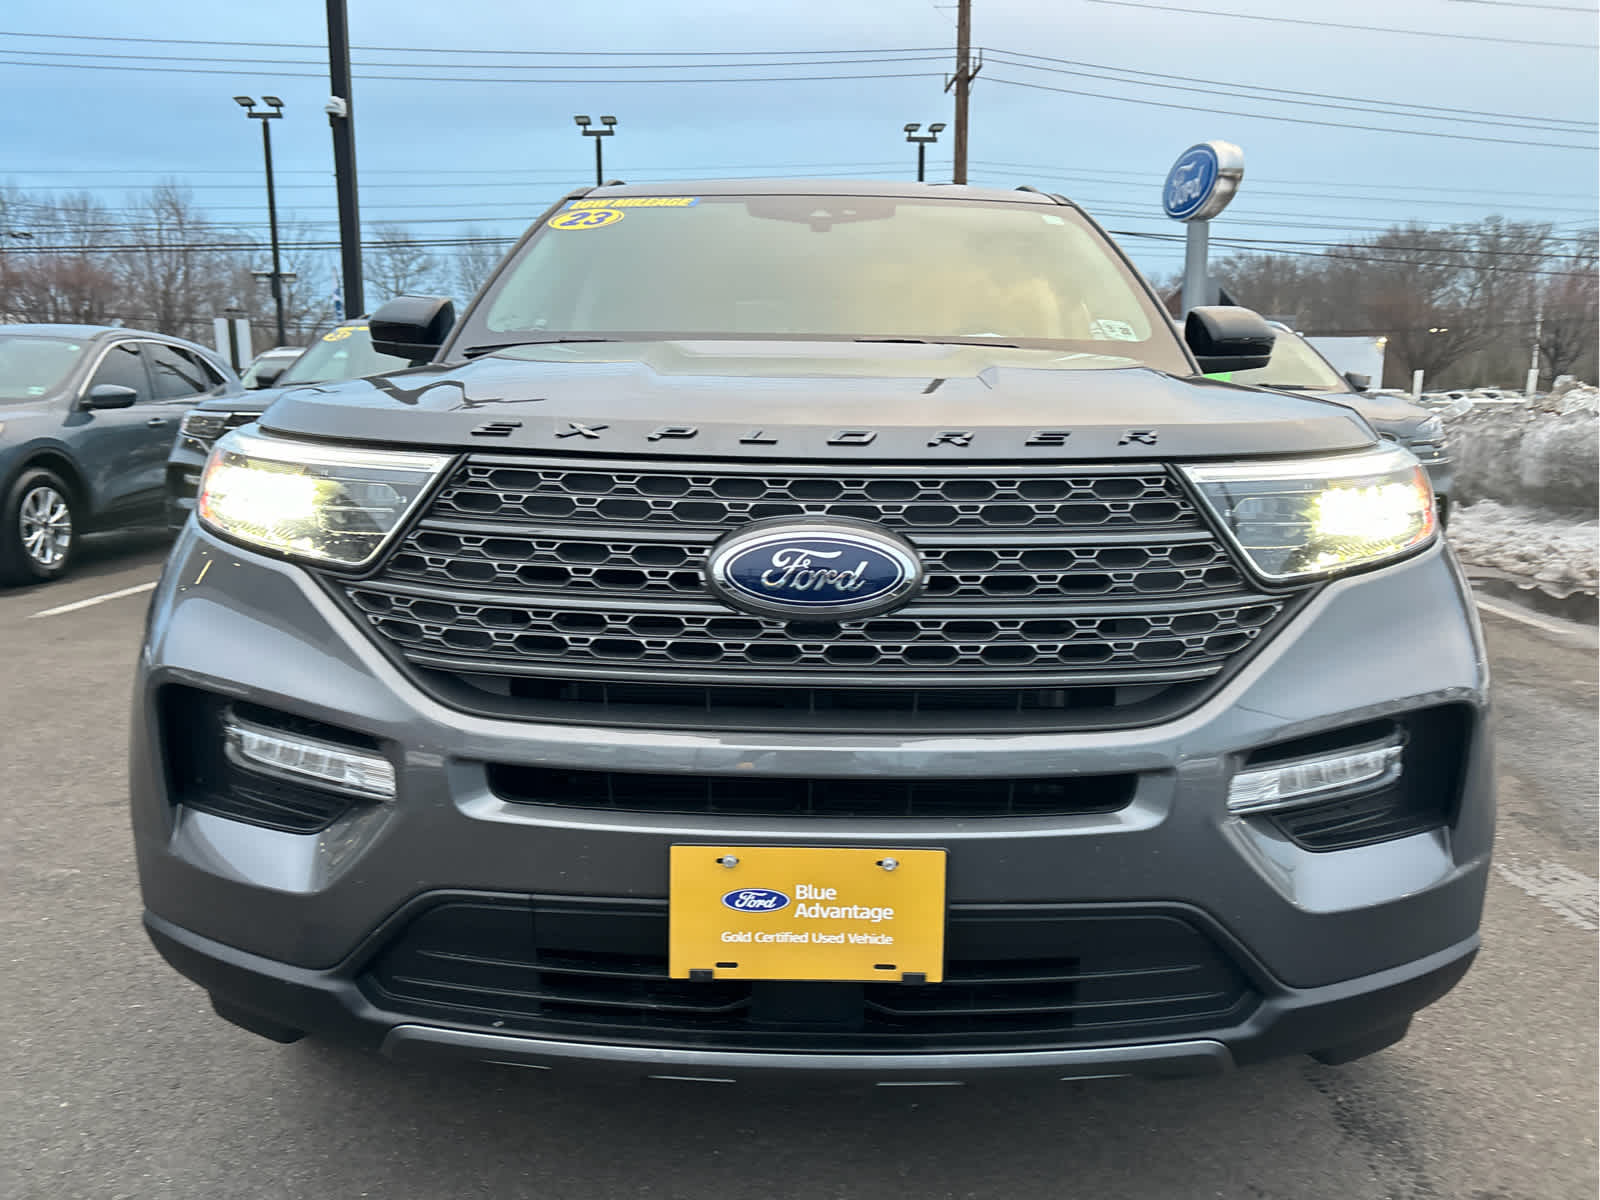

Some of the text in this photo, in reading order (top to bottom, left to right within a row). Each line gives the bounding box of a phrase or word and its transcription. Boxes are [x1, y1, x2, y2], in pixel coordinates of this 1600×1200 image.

[1169, 161, 1205, 208] Ford
[611, 198, 693, 208] MILEAGE
[560, 211, 612, 226] 23
[470, 420, 1157, 447] EXPLORER
[761, 548, 868, 592] Ford
[734, 892, 777, 909] Ford
[795, 884, 837, 900] Blue
[794, 903, 894, 922] Advantage
[721, 932, 893, 945] Gold Certified Used Vehicle
